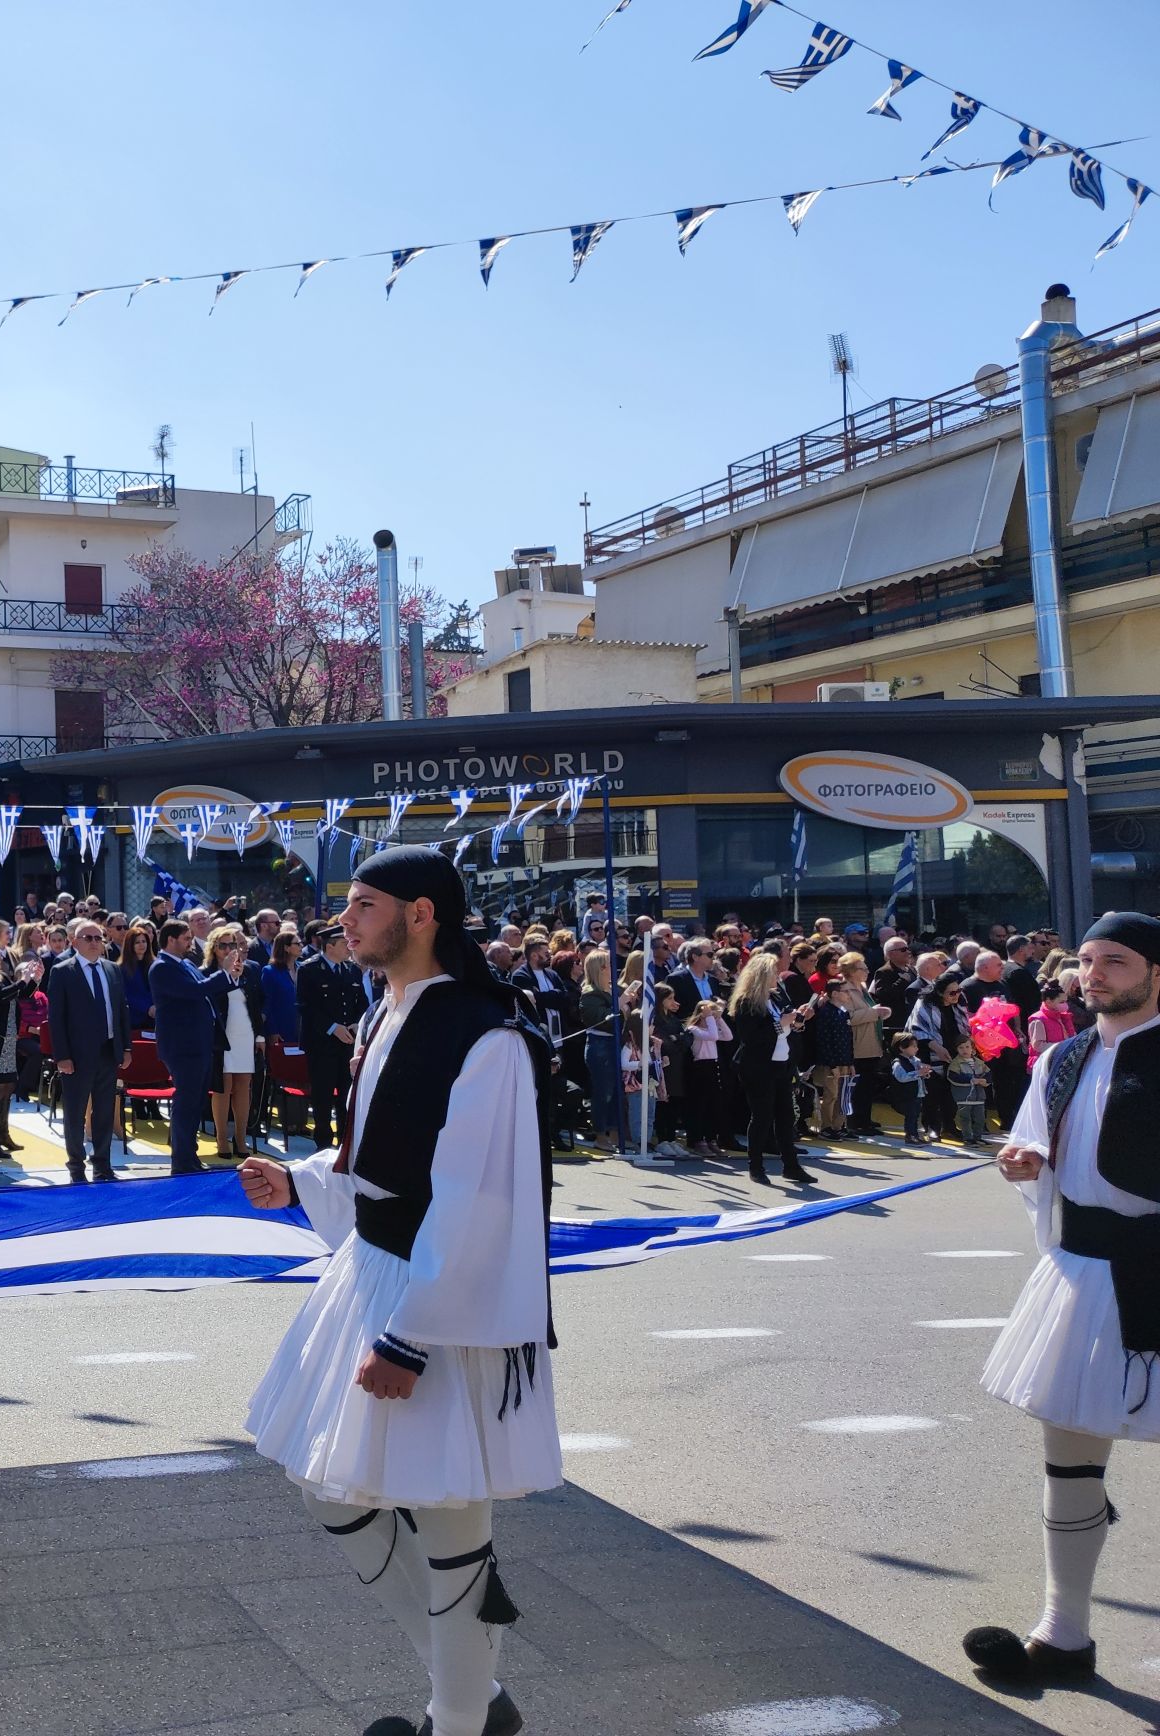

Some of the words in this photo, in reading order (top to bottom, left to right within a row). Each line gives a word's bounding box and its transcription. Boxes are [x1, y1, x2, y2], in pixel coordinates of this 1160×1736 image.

[817, 782, 936, 798] ΦΩΤΟΓΡΑΦΕΙΟ
[982, 811, 1006, 819] Kodak
[1007, 811, 1036, 820] Express
